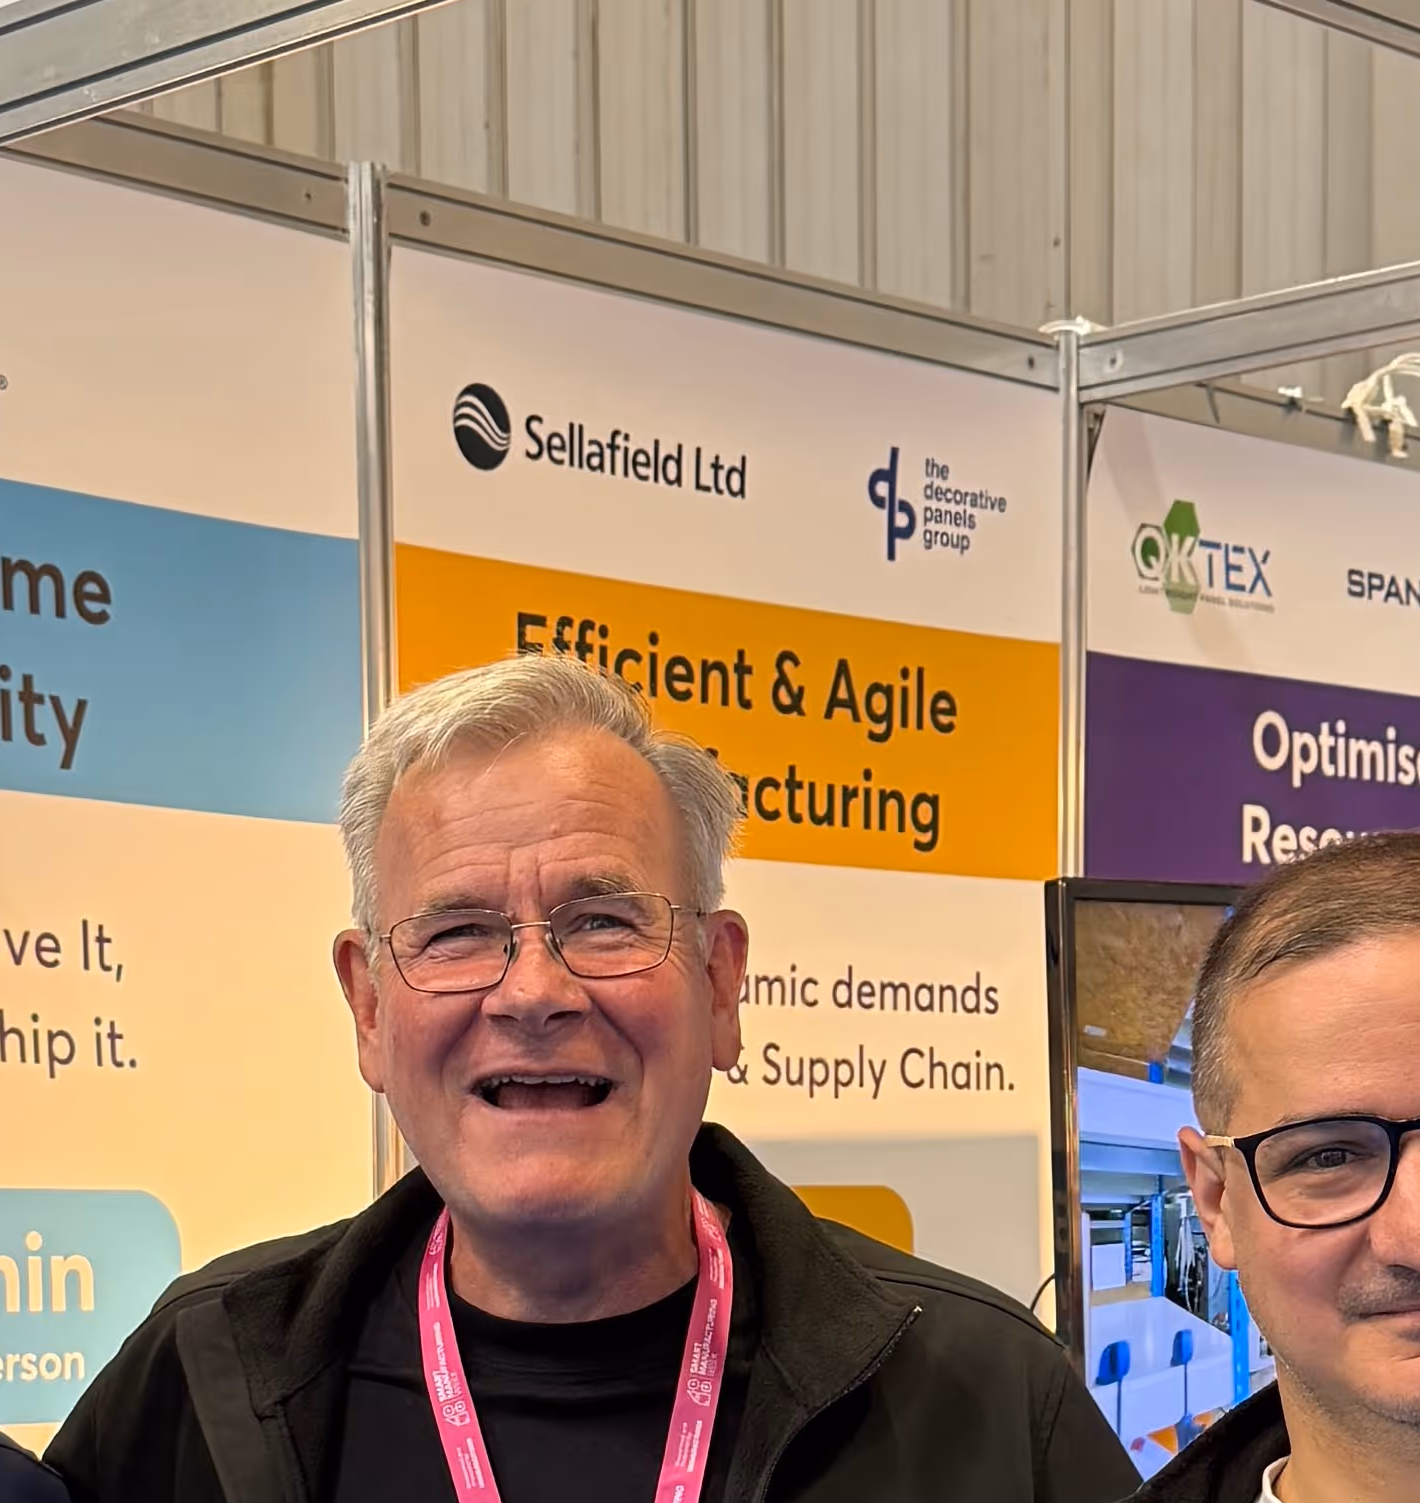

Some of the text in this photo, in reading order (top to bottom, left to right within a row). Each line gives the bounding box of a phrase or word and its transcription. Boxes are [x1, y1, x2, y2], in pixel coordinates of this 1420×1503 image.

[525, 414, 747, 499] Sellafield Ltd
[925, 458, 949, 480] the
[923, 481, 1007, 513] decorative
[923, 505, 976, 530] panels
[923, 529, 970, 555] group
[772, 650, 806, 716] &
[824, 658, 957, 743] Agile
[82, 919, 124, 982] It,
[832, 964, 999, 1016] demands
[94, 1014, 139, 1070] it.
[762, 1042, 887, 1100] Supply
[900, 1046, 1015, 1092] Chain.
